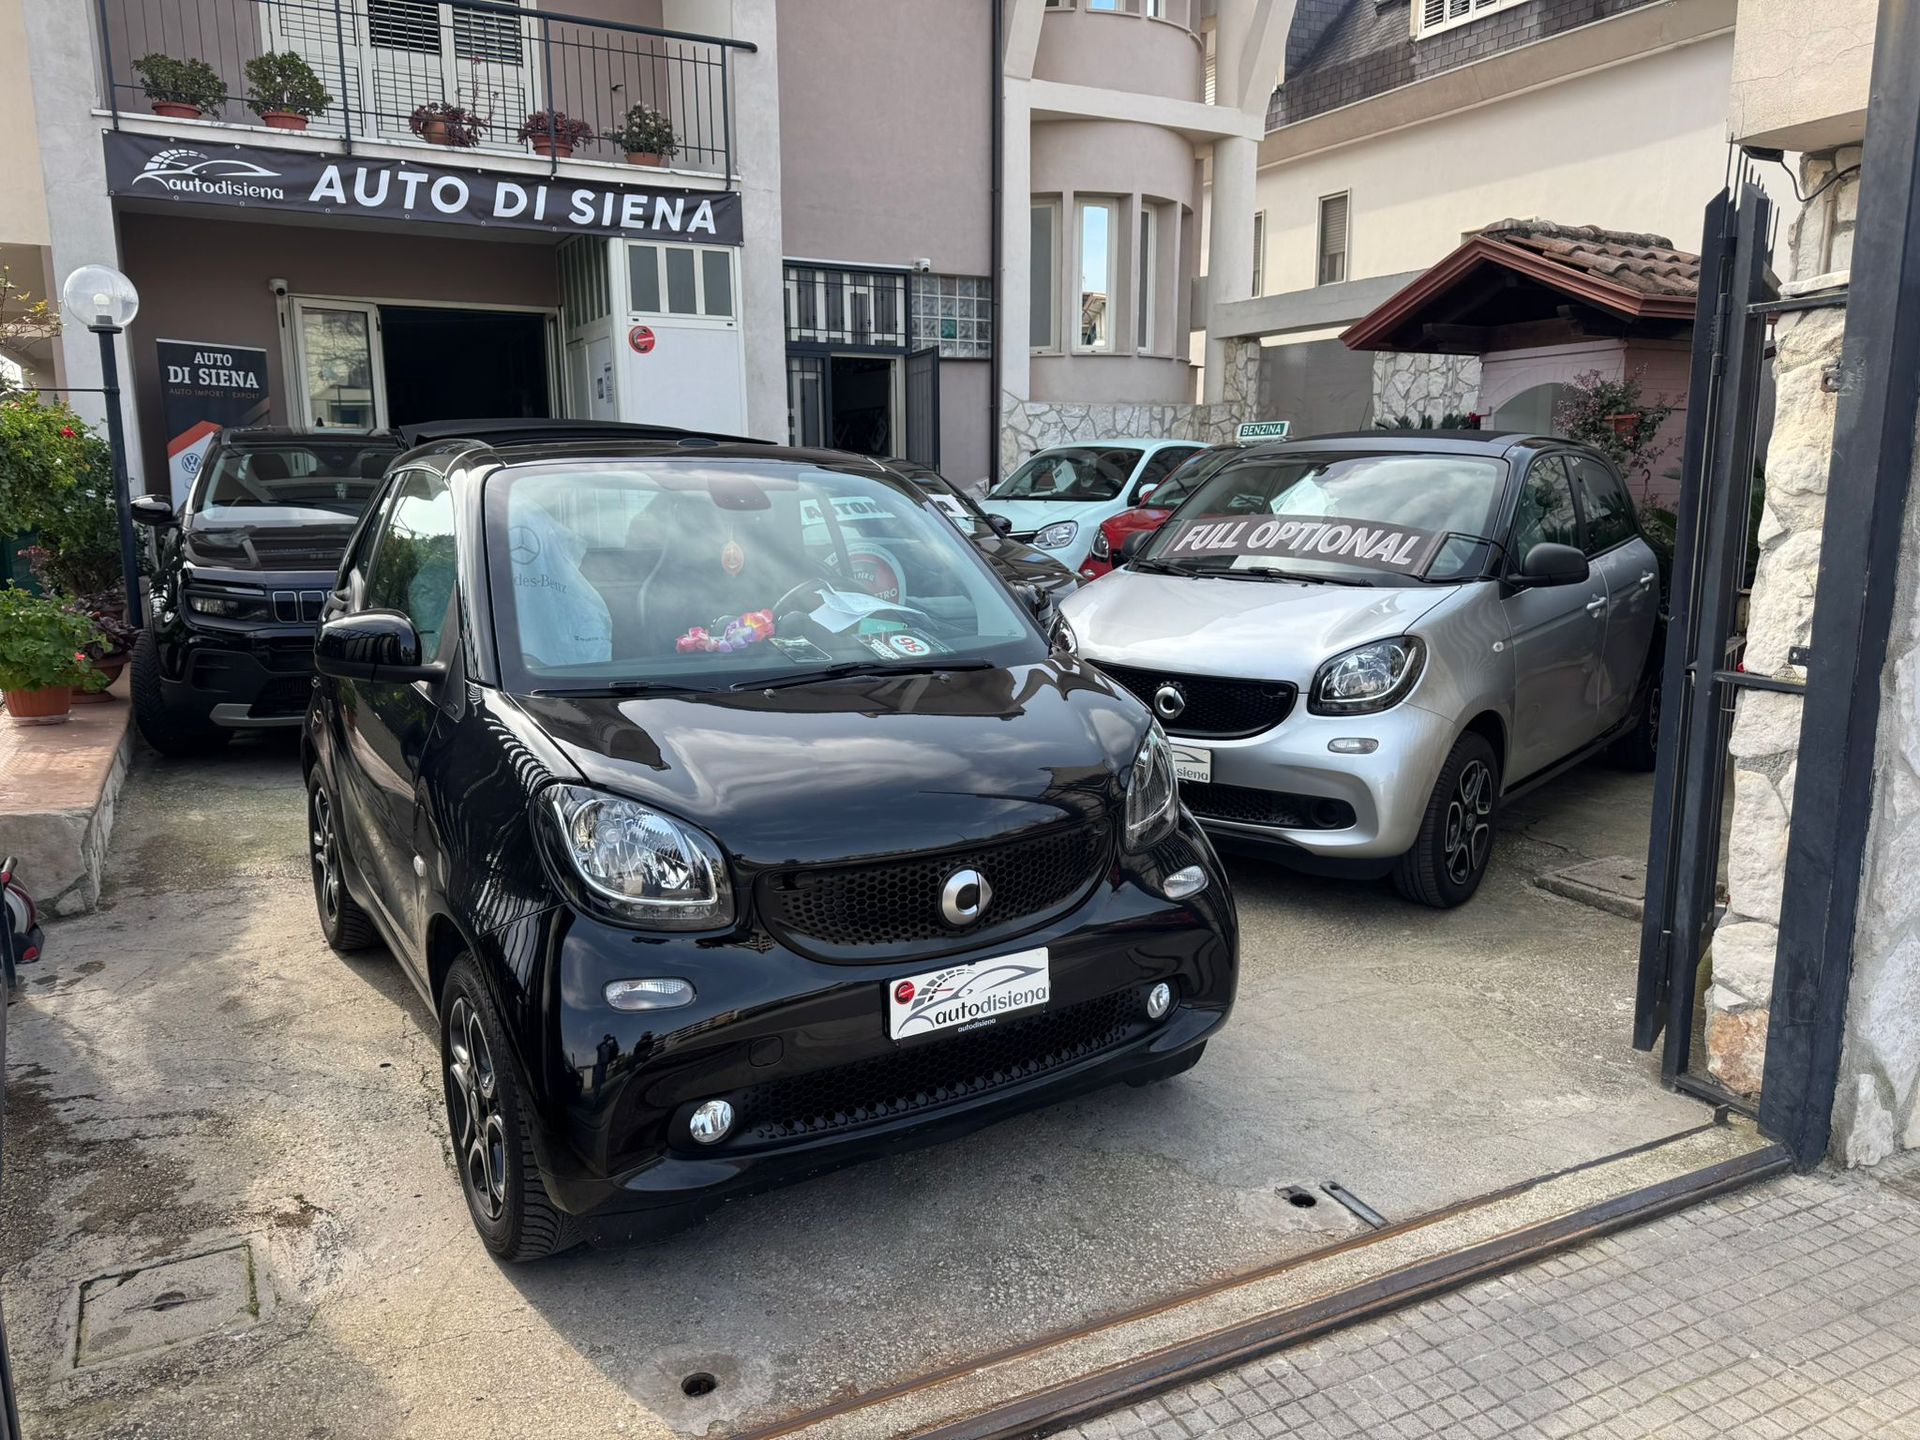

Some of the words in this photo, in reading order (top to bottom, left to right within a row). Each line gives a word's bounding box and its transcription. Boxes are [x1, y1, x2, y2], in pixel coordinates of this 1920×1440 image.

[168, 177, 284, 200] autodisiena
[308, 164, 470, 214] AUTO
[492, 181, 548, 221] DI
[567, 188, 717, 234] SIENA
[193, 351, 233, 367] AUTO
[167, 365, 191, 384] DI
[198, 367, 260, 389] SIENA
[168, 387, 193, 396] AUTO
[194, 388, 225, 398] IMPORT
[1241, 424, 1282, 436] BENZINA
[1172, 520, 1249, 552] FULL
[1245, 519, 1421, 565] OPTIONAL
[934, 985, 1048, 1026] autodisiena
[957, 1017, 997, 1033] autodisiena
